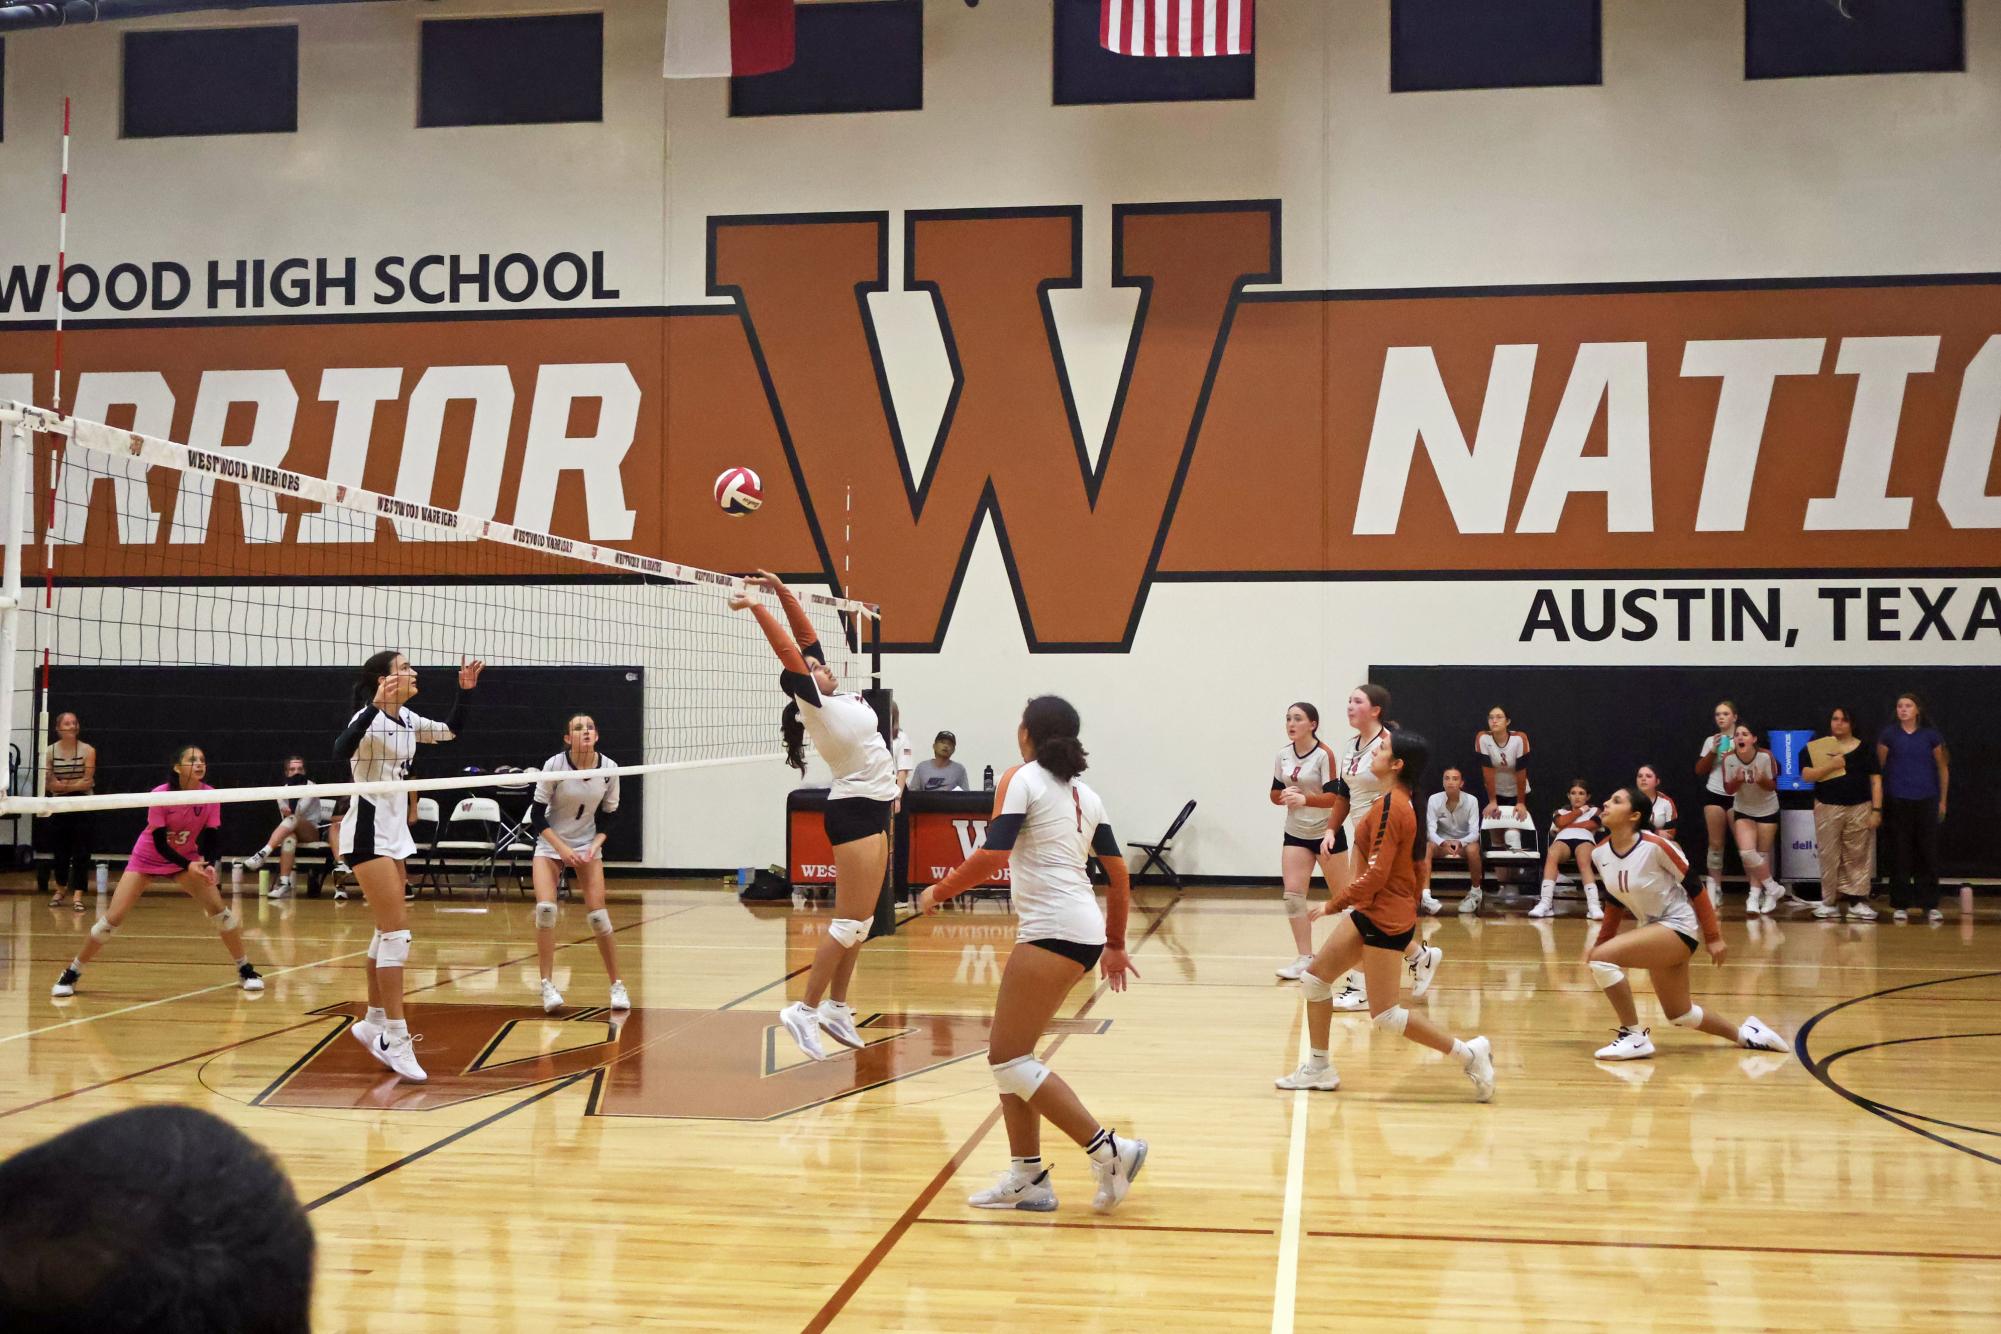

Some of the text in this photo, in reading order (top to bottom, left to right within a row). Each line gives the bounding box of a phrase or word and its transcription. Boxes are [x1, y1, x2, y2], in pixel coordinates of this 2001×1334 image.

[207, 257, 356, 309] HIGH
[374, 250, 620, 305] SCHOOL
[706, 199, 1282, 654] W
[0, 362, 642, 545] RRIOR
[188, 449, 300, 492] WESTWOOD WARRIORS
[377, 495, 419, 519] WESTWOOD
[1518, 587, 1799, 648] AUSTIN,
[1792, 840, 1812, 850] dell
[1618, 870, 1629, 893] 11
